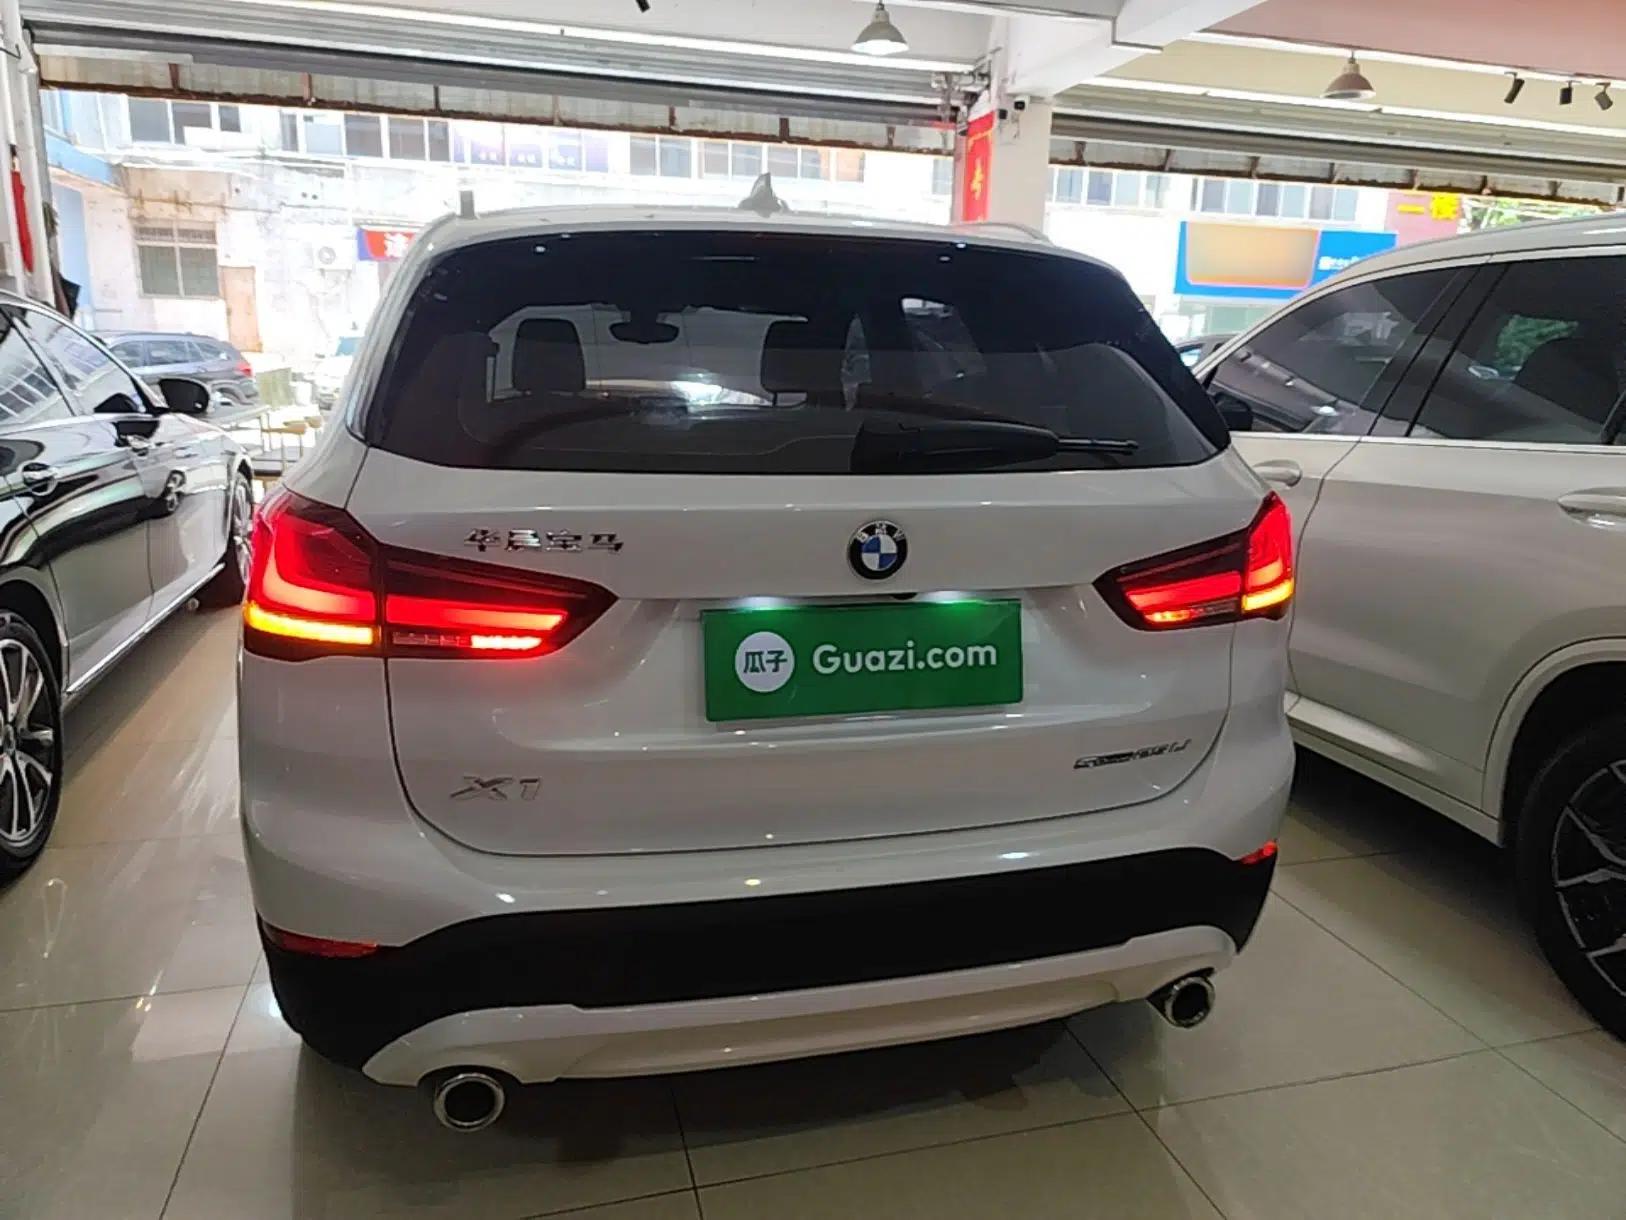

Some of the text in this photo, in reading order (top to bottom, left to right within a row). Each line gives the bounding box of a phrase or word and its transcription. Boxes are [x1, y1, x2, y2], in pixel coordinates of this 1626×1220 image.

[743, 650, 788, 674] 瓜子
[812, 640, 997, 674] Guazi.com
[450, 775, 541, 801] X1
